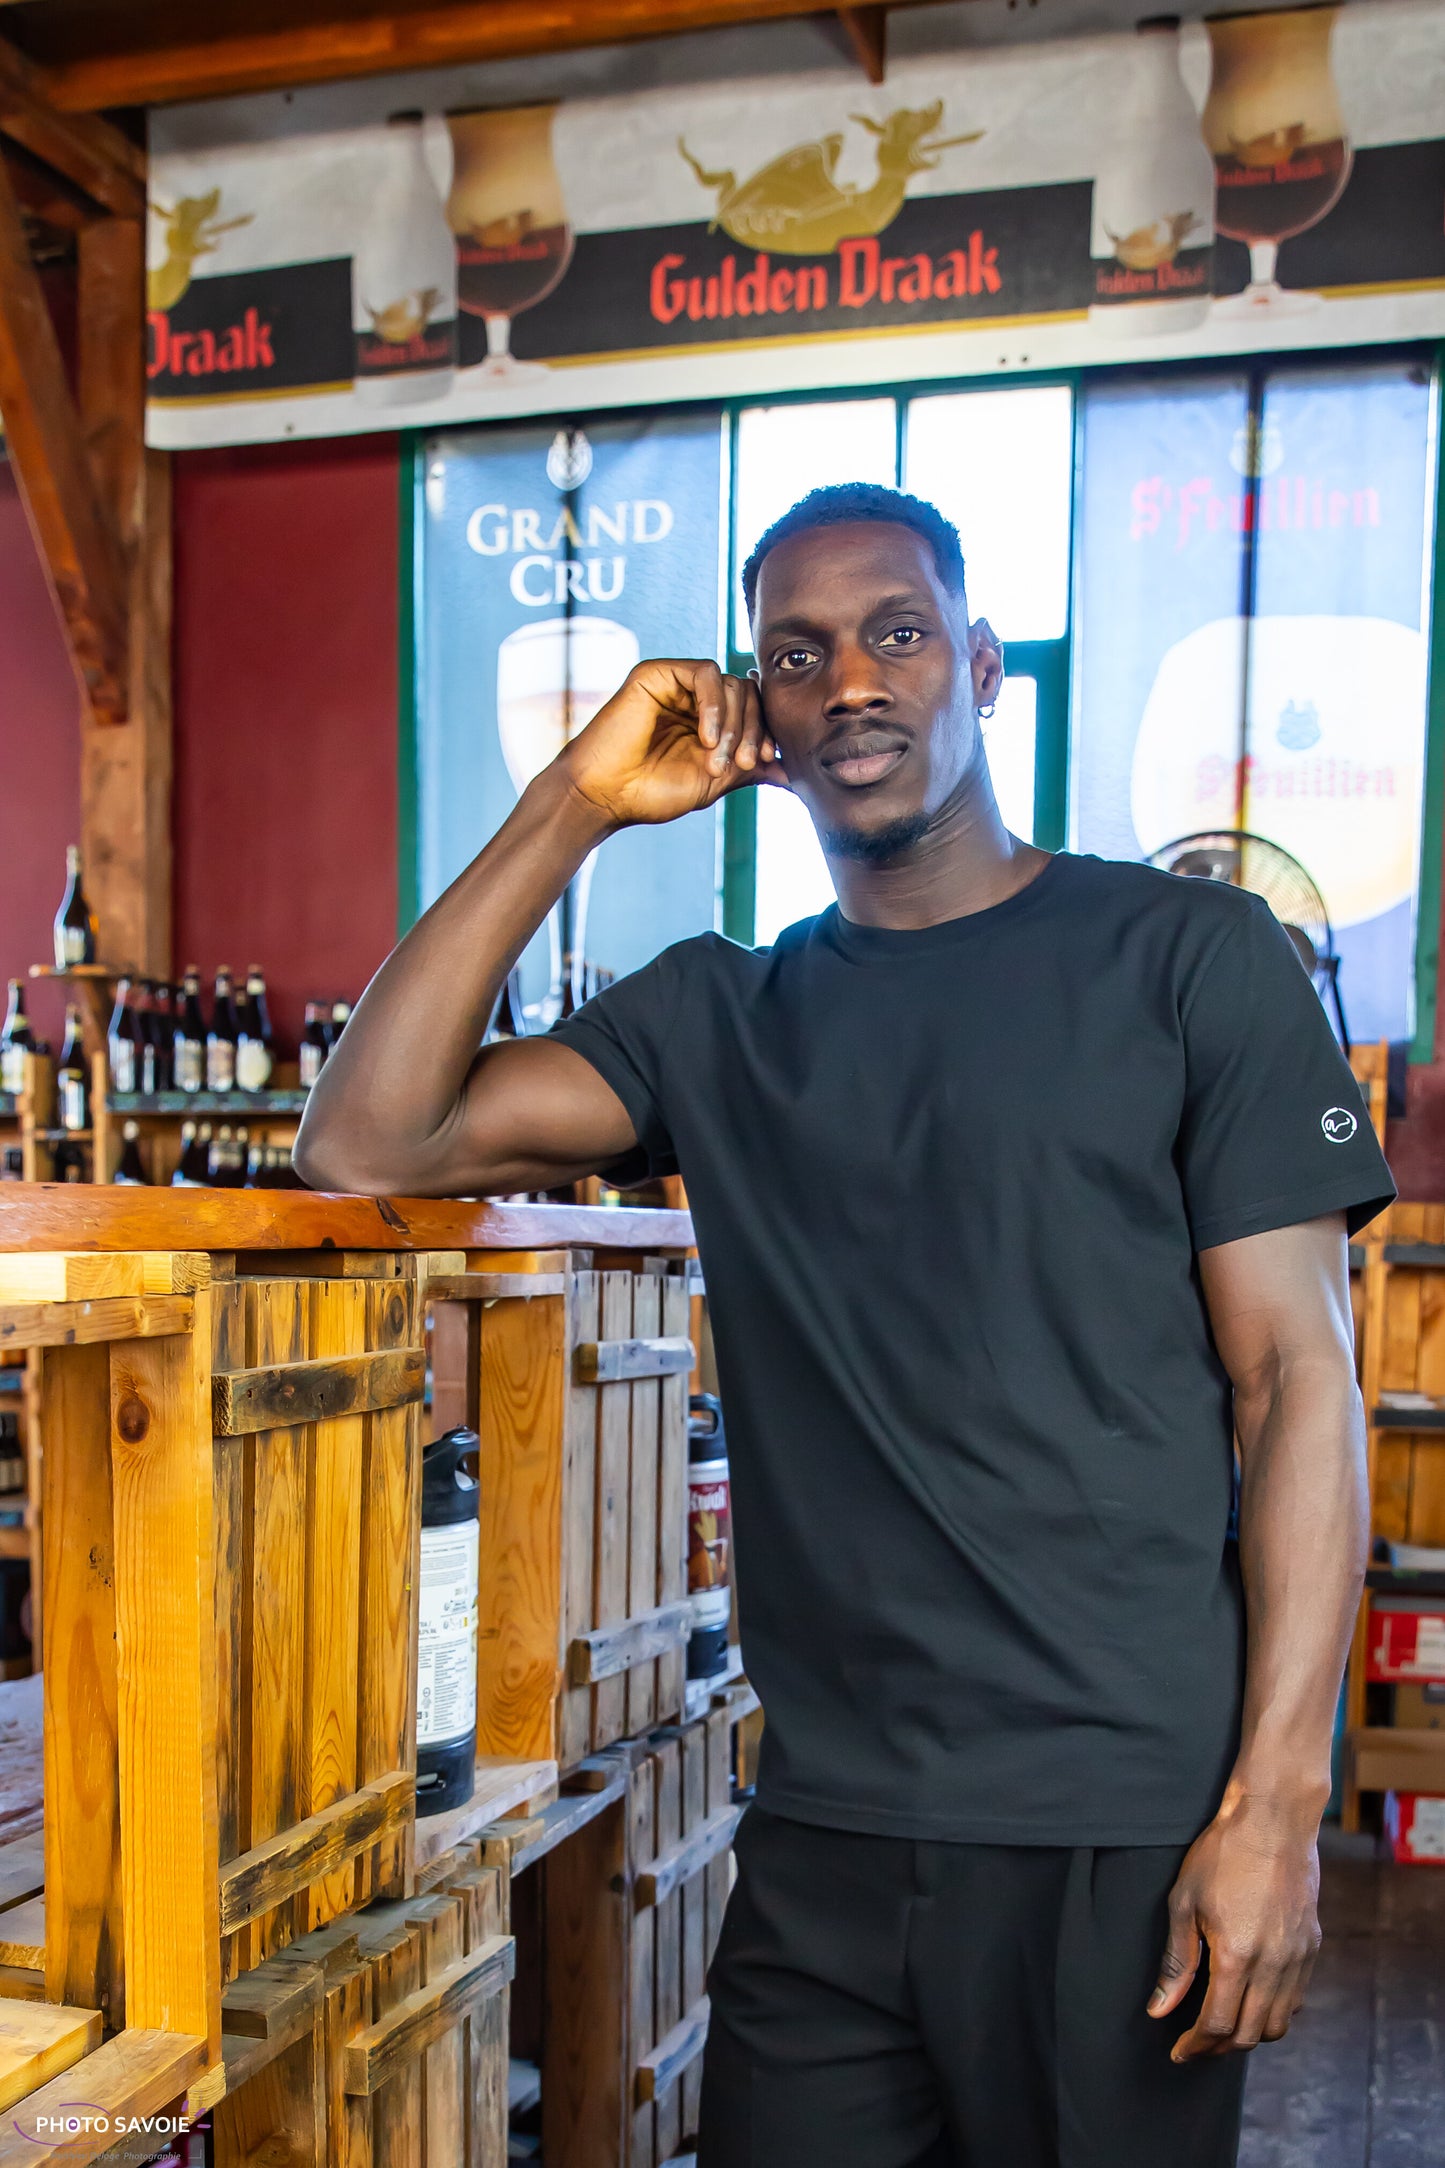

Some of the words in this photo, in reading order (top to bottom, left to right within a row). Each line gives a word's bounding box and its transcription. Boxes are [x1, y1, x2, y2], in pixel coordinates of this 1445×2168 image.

[651, 253, 828, 324] Gulden
[836, 230, 1002, 308] Draak
[466, 499, 674, 556] GRAND
[509, 554, 627, 607] CRU
